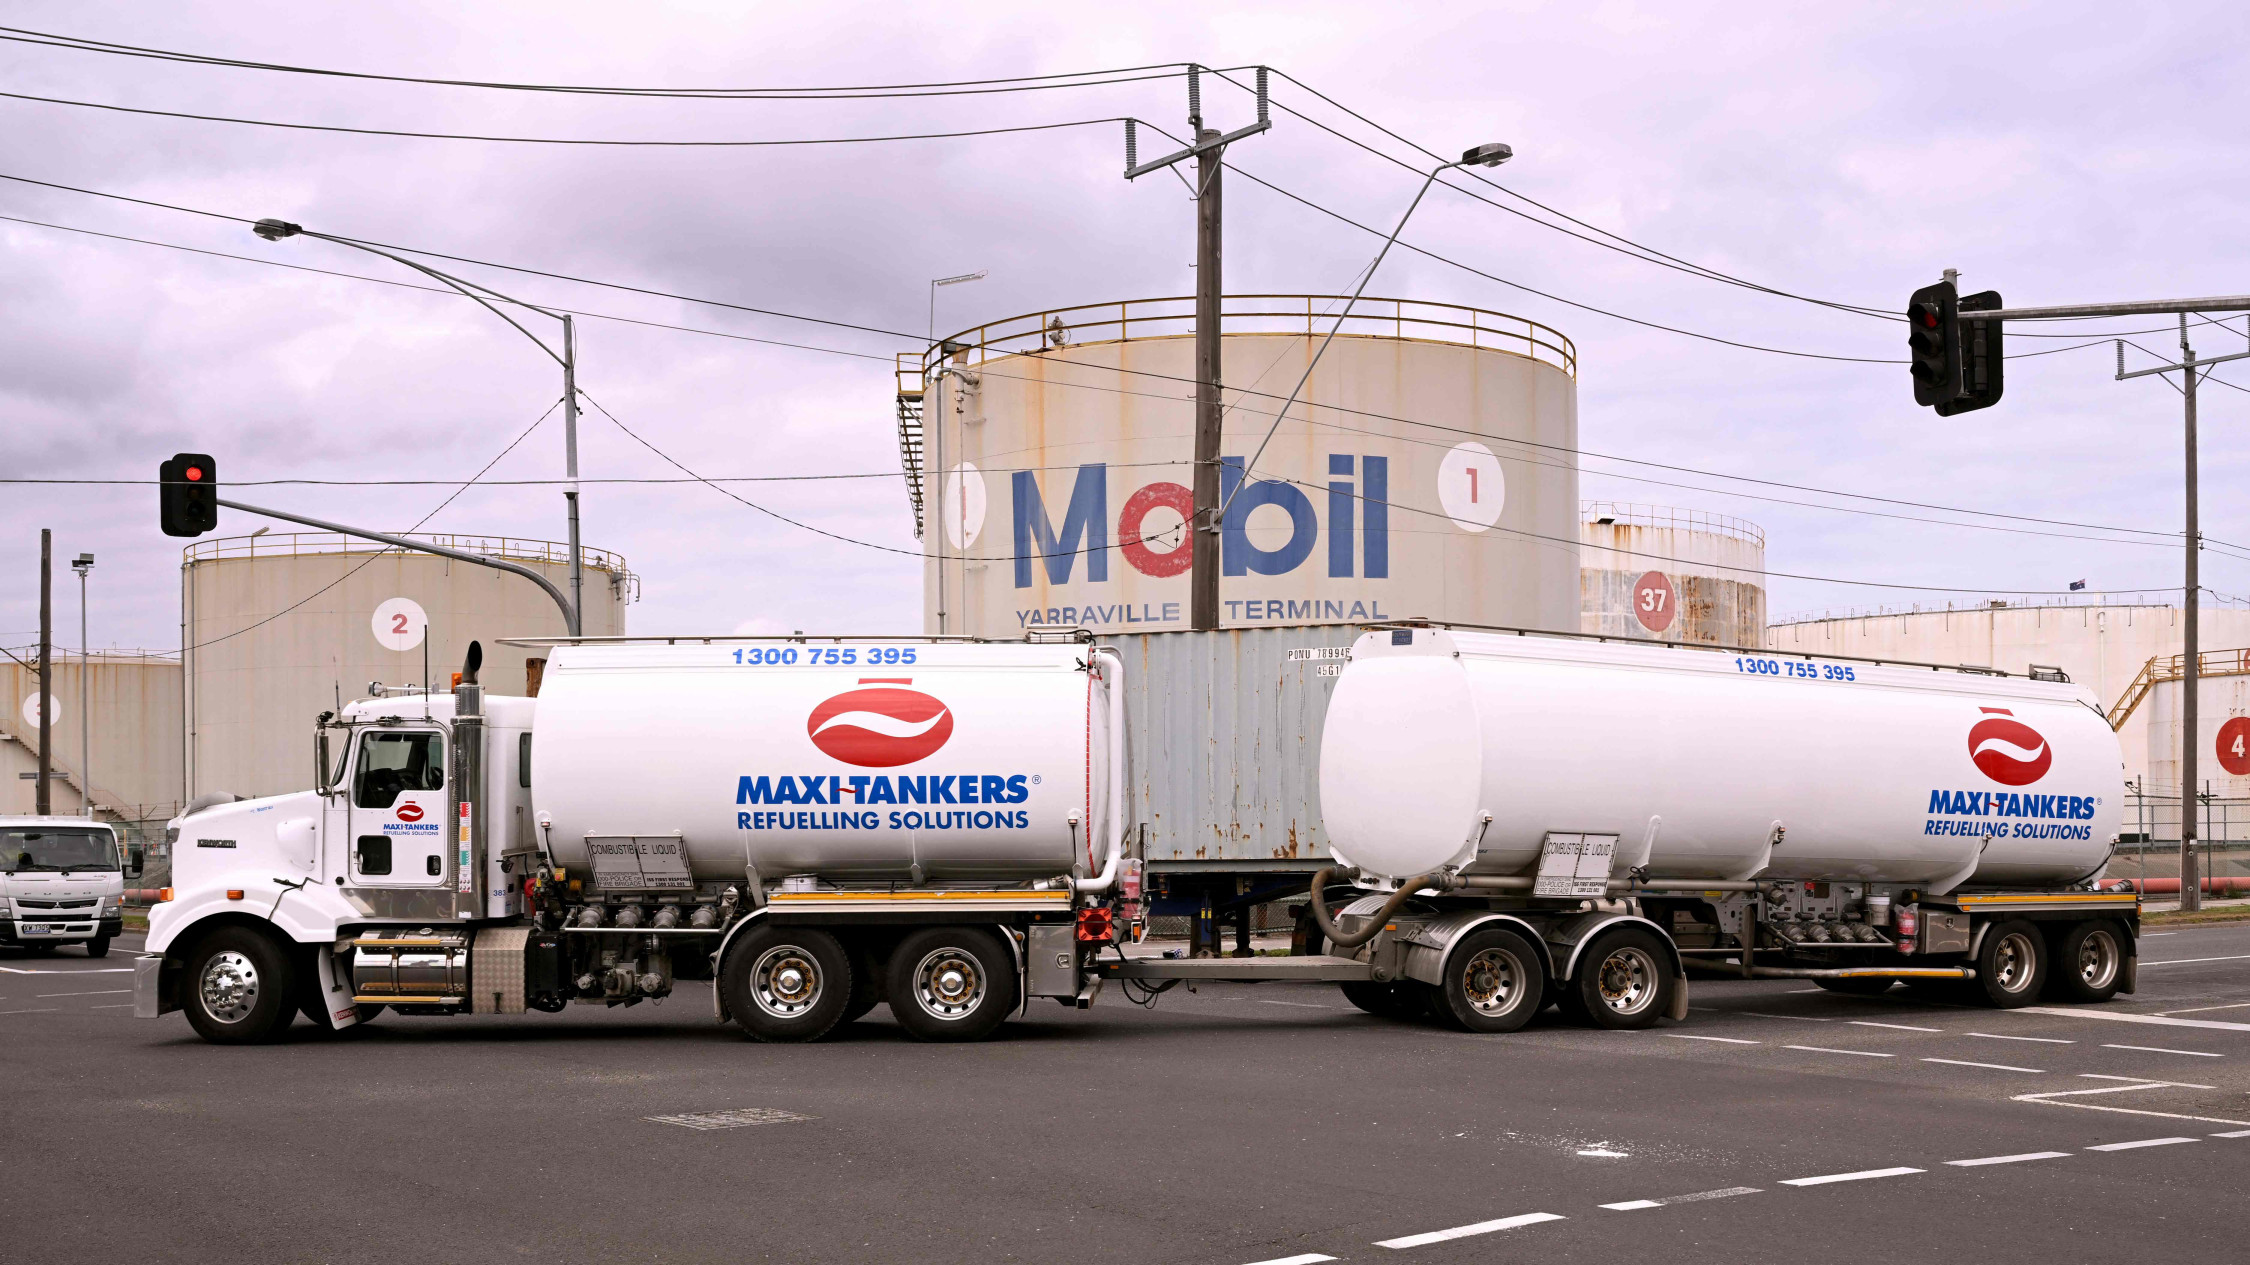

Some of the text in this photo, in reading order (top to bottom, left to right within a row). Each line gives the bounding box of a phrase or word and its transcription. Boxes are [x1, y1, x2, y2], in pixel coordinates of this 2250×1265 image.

[1466, 467, 1478, 504] 1
[1012, 454, 1389, 588] Mobil
[1641, 588, 1667, 612] 37
[391, 613, 408, 634] 2
[1016, 600, 1389, 629] YARRAVILLE TERMINAL
[732, 647, 917, 665] 1300 755 395
[1735, 657, 1856, 682] 1300 755 395
[2231, 734, 2246, 758] 4
[736, 774, 1029, 805] MAXI-TANKERS
[1928, 789, 2096, 820] MAXI-TANKERS
[737, 810, 1029, 830] REFUELLING SOLUTIONS
[1924, 819, 2092, 841] REFUELLING SOLUTIONS
[591, 844, 677, 855] COMBUSTIBLE LIQUID
[1547, 842, 1611, 856] COMBUSTIBLE LIQUID
